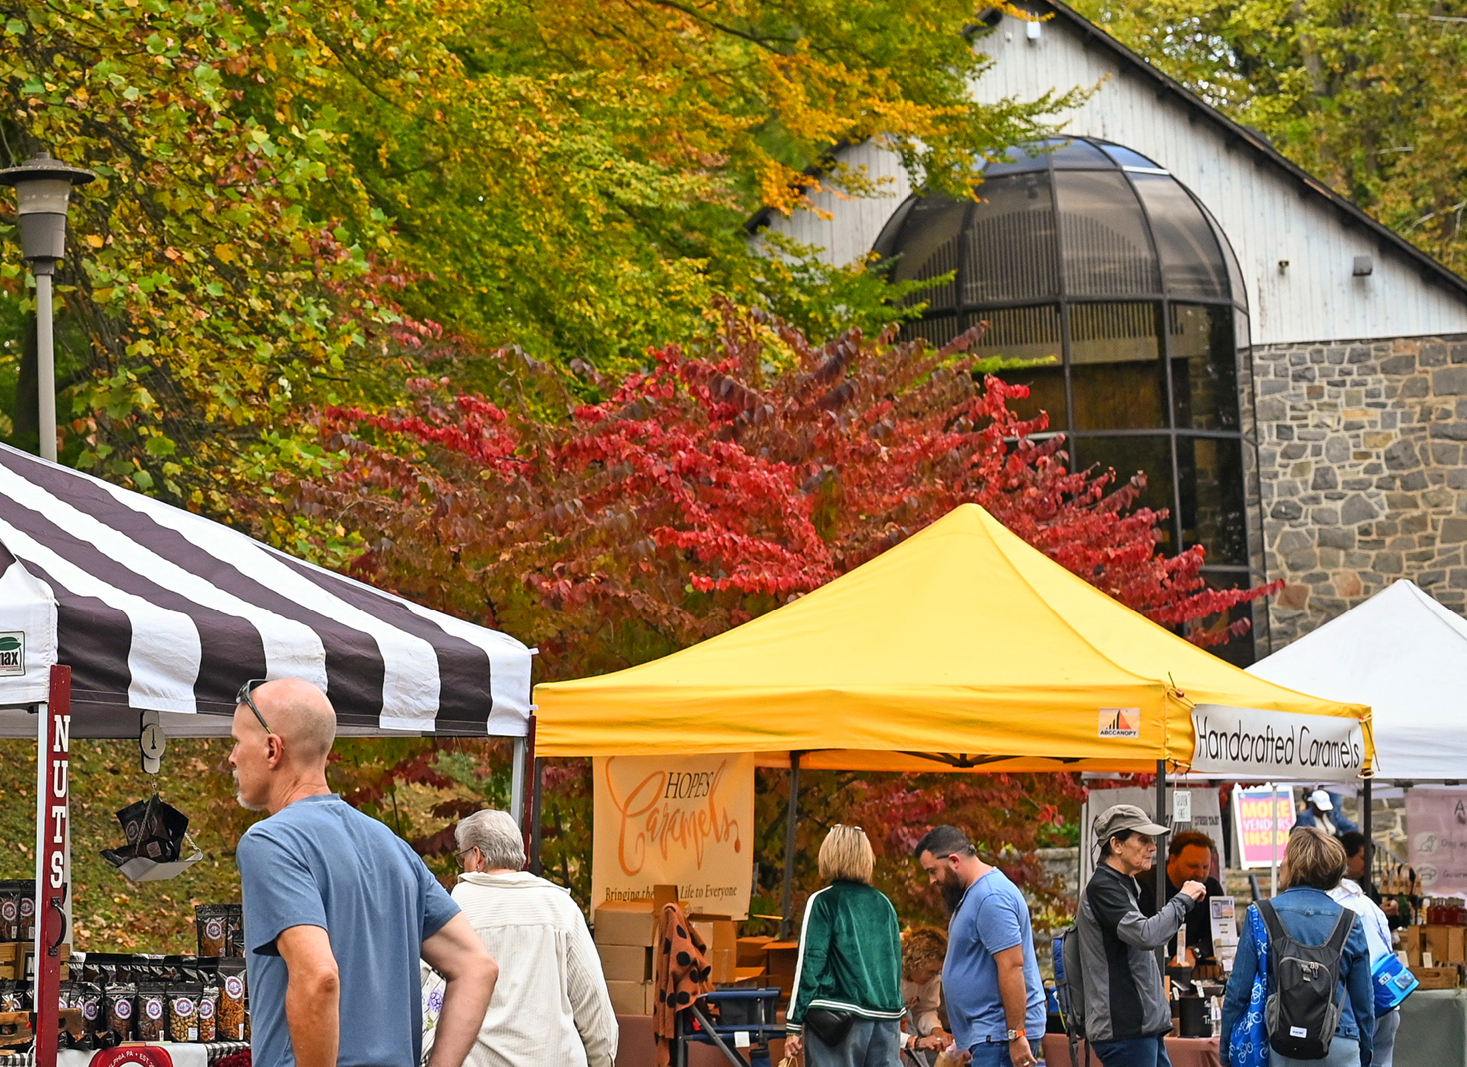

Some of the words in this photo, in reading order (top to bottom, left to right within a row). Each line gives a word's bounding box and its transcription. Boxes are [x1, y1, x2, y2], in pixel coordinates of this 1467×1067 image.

[1194, 714, 1295, 766] Handcrafted
[1298, 724, 1360, 770] Caramels
[50, 714, 71, 889] NUTS
[606, 756, 742, 877] Caramels
[680, 884, 694, 899] Life
[695, 887, 704, 898] to
[704, 884, 738, 901] Everyone
